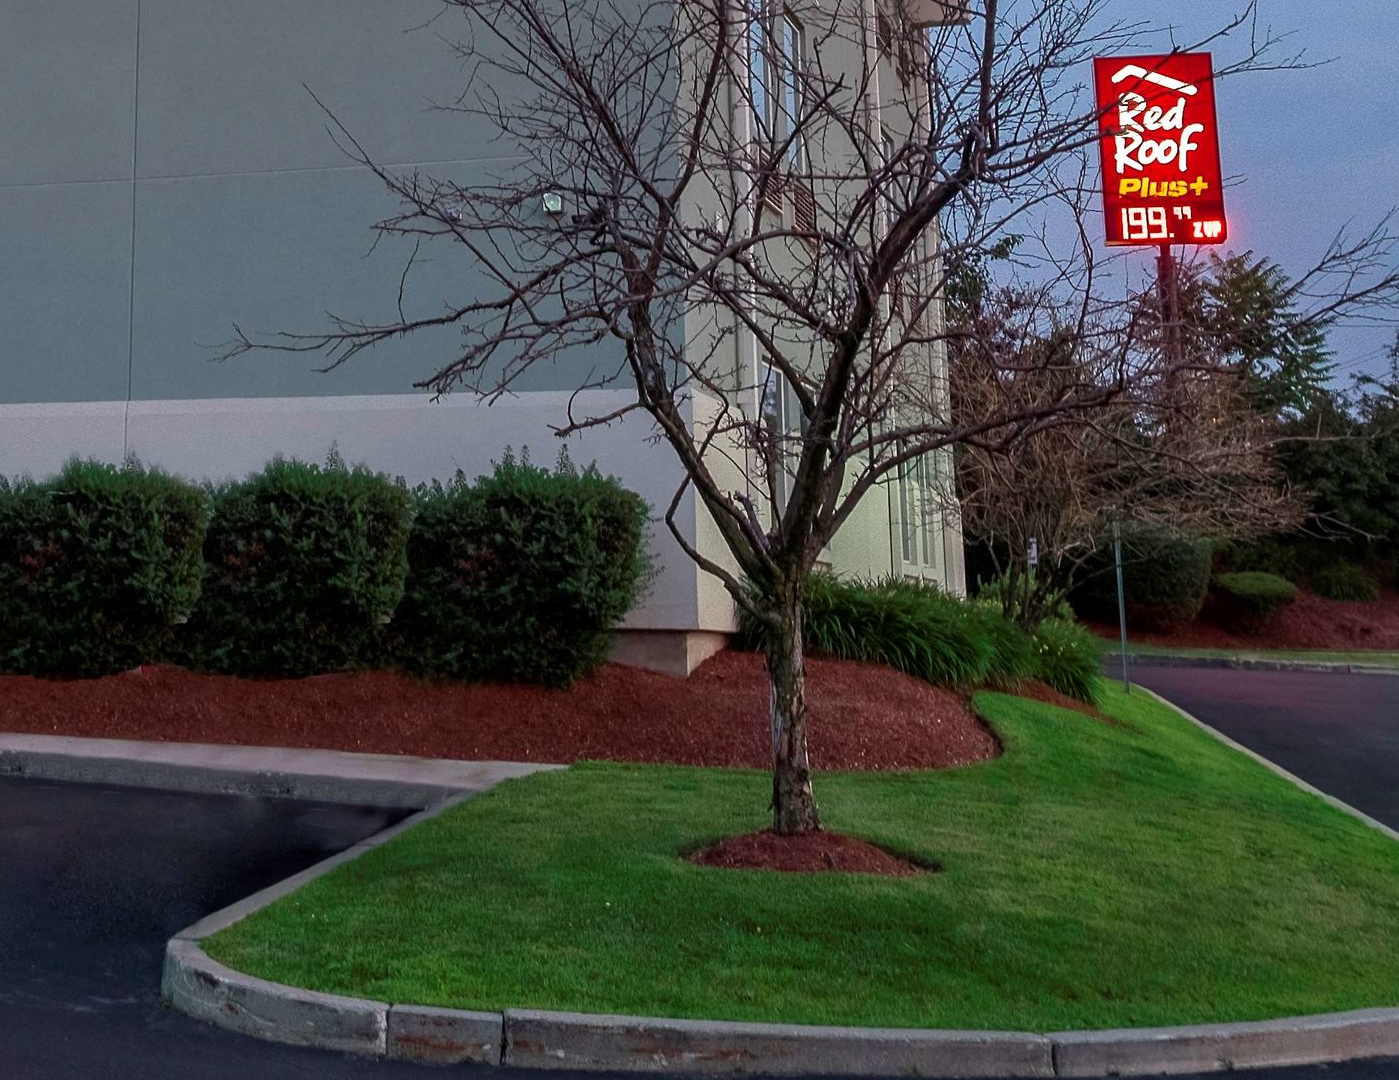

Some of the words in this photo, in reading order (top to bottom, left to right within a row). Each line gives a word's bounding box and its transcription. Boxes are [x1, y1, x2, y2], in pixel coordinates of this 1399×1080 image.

[1118, 92, 1186, 133] Red
[1114, 124, 1204, 174] Roof
[1119, 176, 1209, 198] Plus+
